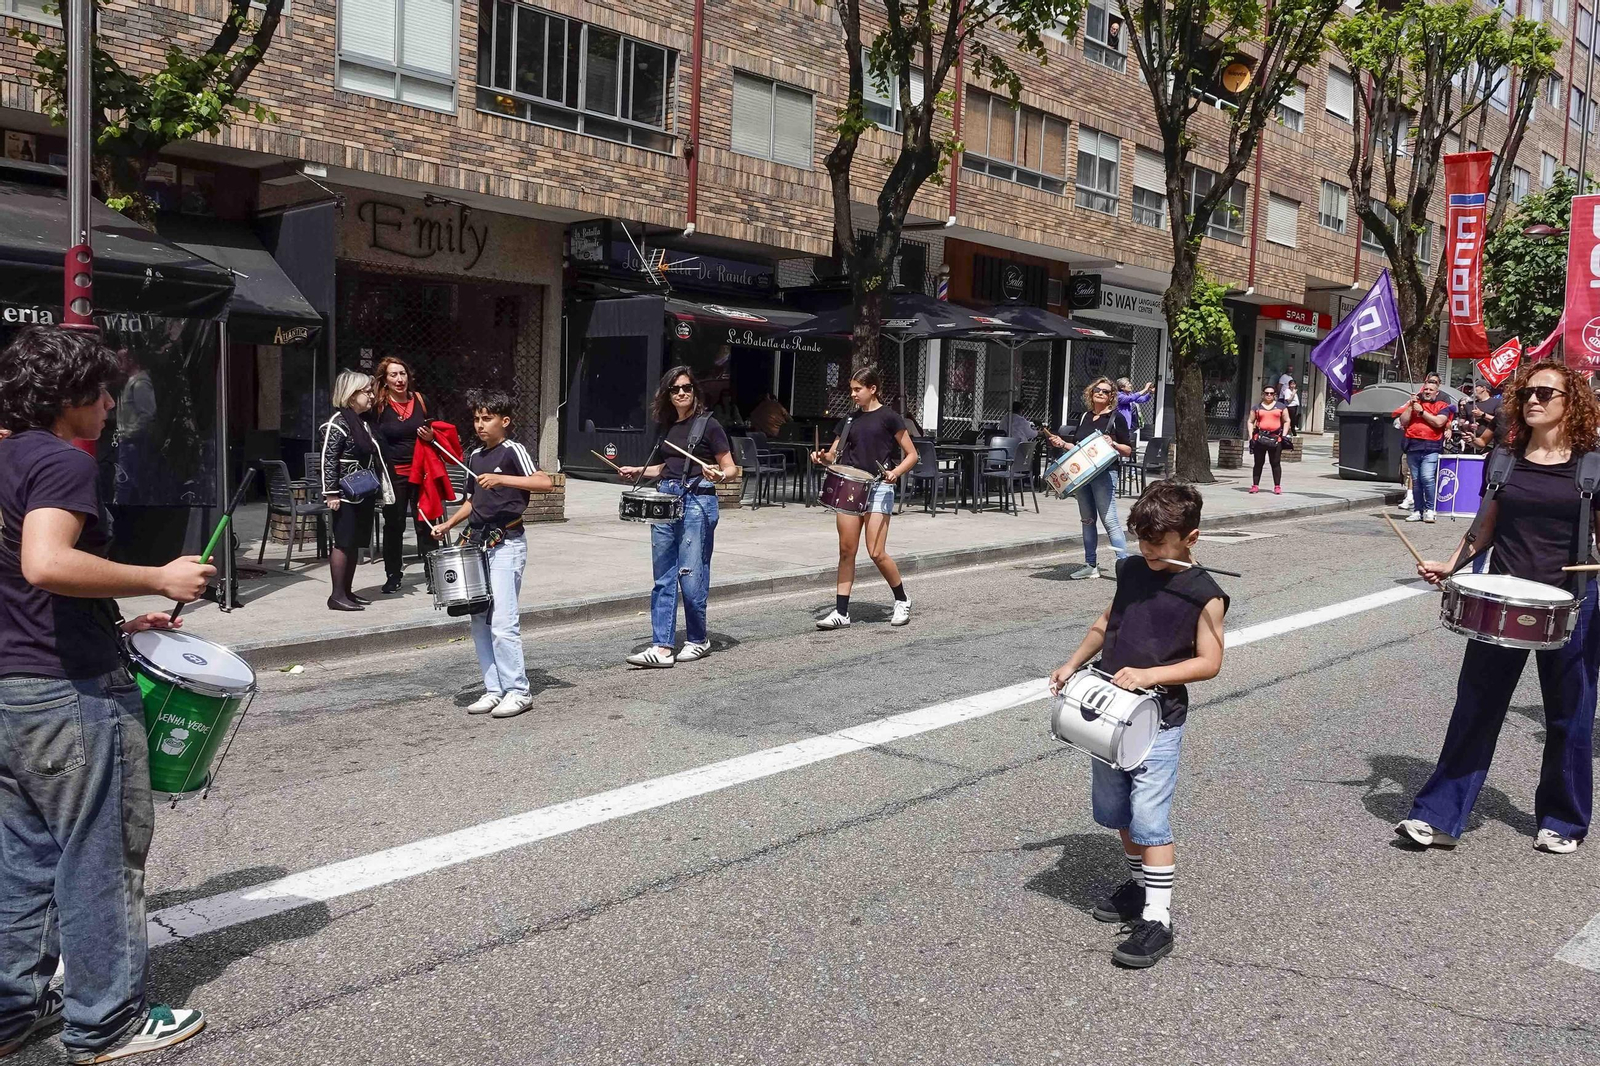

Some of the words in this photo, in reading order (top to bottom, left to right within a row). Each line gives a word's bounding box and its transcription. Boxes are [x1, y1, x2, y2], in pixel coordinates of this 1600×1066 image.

[358, 200, 488, 270] Emily
[717, 264, 753, 286] Rande
[1452, 215, 1477, 317] CCOO
[1006, 271, 1024, 287] Gala
[1074, 282, 1095, 295] Gala
[1100, 290, 1113, 307] IS
[1115, 293, 1138, 311] WAY
[1139, 297, 1161, 308] LANGUAGE
[1138, 305, 1153, 314] CENTER
[2, 305, 54, 325] ería
[1286, 310, 1306, 321] SPAR
[1294, 325, 1315, 333] express
[726, 328, 741, 344] La
[742, 330, 781, 349] Batalla
[781, 338, 791, 350] de
[790, 335, 822, 353] Rande
[158, 713, 186, 726] LENHA
[187, 720, 210, 734] VERDE
